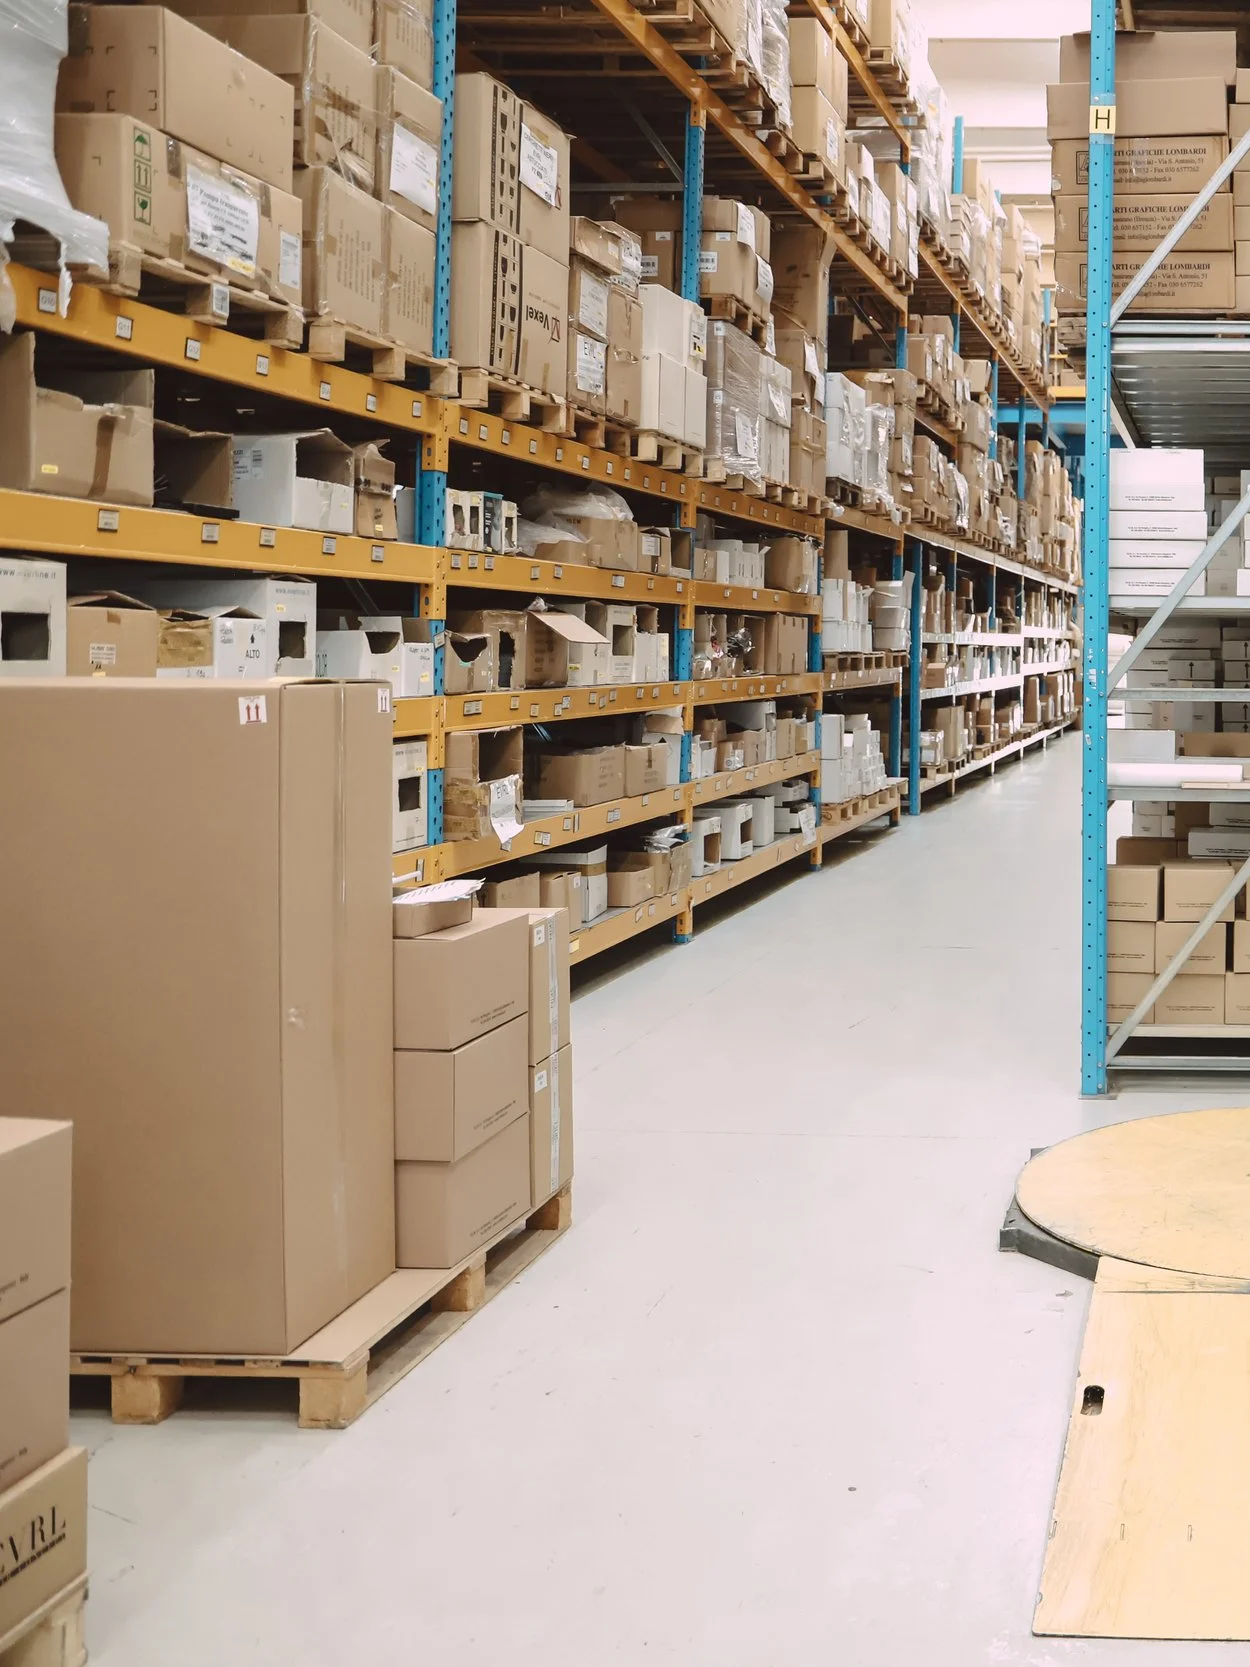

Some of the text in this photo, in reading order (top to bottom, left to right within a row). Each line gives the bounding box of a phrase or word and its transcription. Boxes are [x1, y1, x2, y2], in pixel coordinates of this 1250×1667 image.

[1096, 109, 1110, 129] H
[1113, 148, 1207, 157] RTI GRAFICHE LOMBARDI
[1174, 158, 1197, 166] Antonio,
[526, 305, 550, 331] Vexel
[245, 649, 260, 659] ALTO
